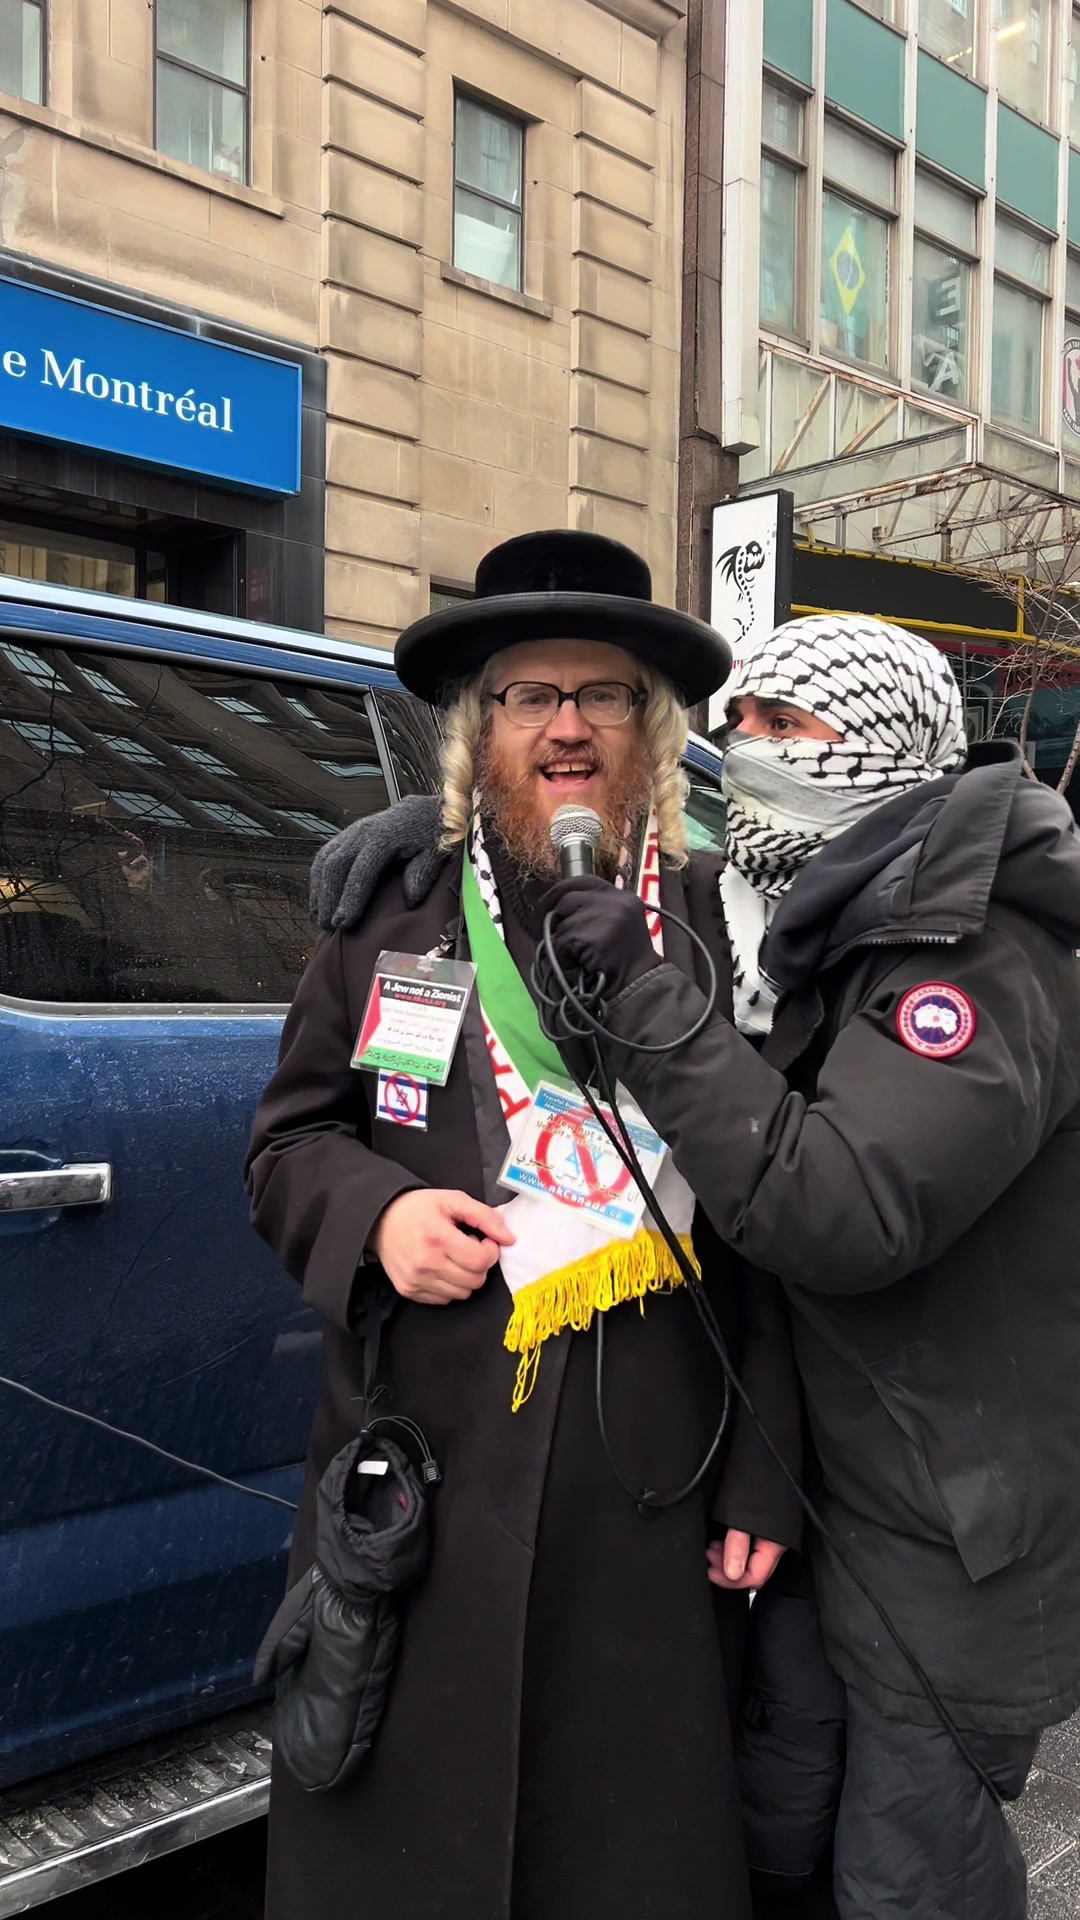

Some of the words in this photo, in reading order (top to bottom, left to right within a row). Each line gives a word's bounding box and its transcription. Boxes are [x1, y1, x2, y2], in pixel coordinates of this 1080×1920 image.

[40, 348, 234, 433] Montréal
[383, 980, 391, 990] A
[391, 982, 409, 993] Jew
[409, 987, 424, 996] not
[424, 989, 431, 997] a
[431, 988, 462, 1003] Zionist
[547, 1112, 554, 1121] A
